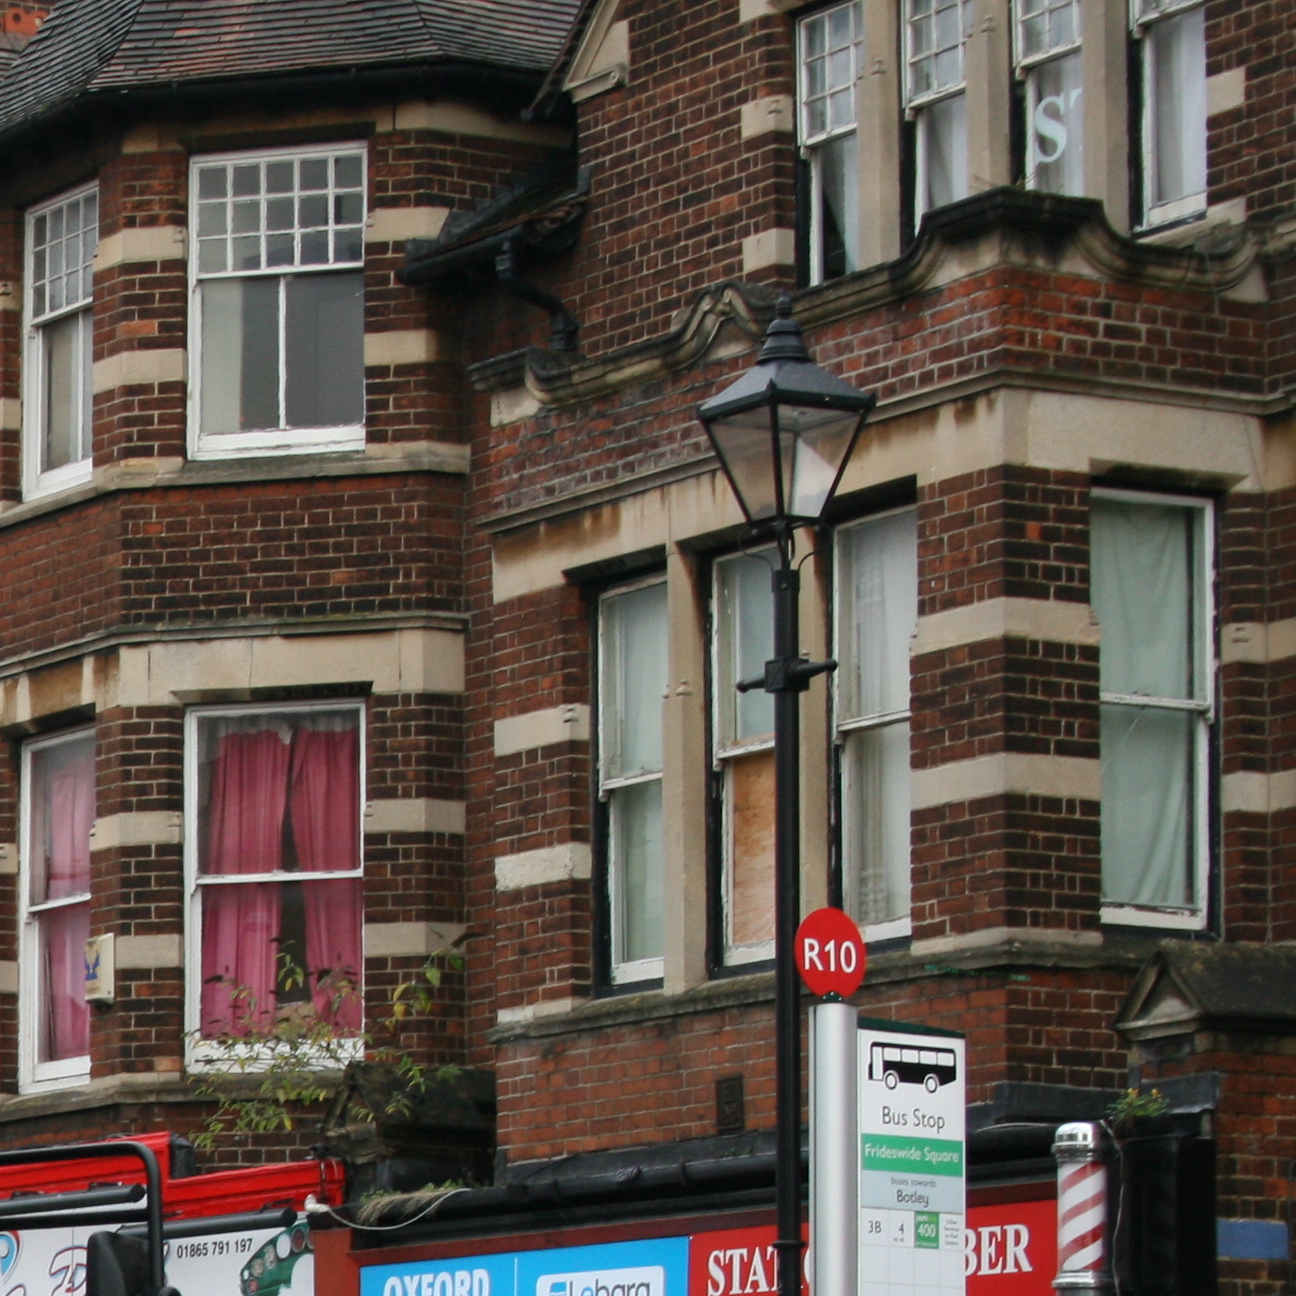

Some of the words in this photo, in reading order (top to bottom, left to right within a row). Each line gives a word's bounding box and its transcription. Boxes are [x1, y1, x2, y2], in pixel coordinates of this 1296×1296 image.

[1033, 87, 1082, 163] S
[803, 937, 857, 974] R10
[882, 1105, 908, 1126] Bus
[912, 1108, 945, 1134] Stop
[864, 1143, 922, 1161] Frideswide
[923, 1146, 959, 1165] Square
[896, 1189, 929, 1208] Botley
[868, 1220, 882, 1233] 3B
[898, 1222, 905, 1235] 4
[917, 1223, 936, 1237] 400
[177, 1242, 209, 1259] 01865
[212, 1240, 230, 1256] 791
[234, 1238, 254, 1253] 197
[965, 1223, 1033, 1277] BER
